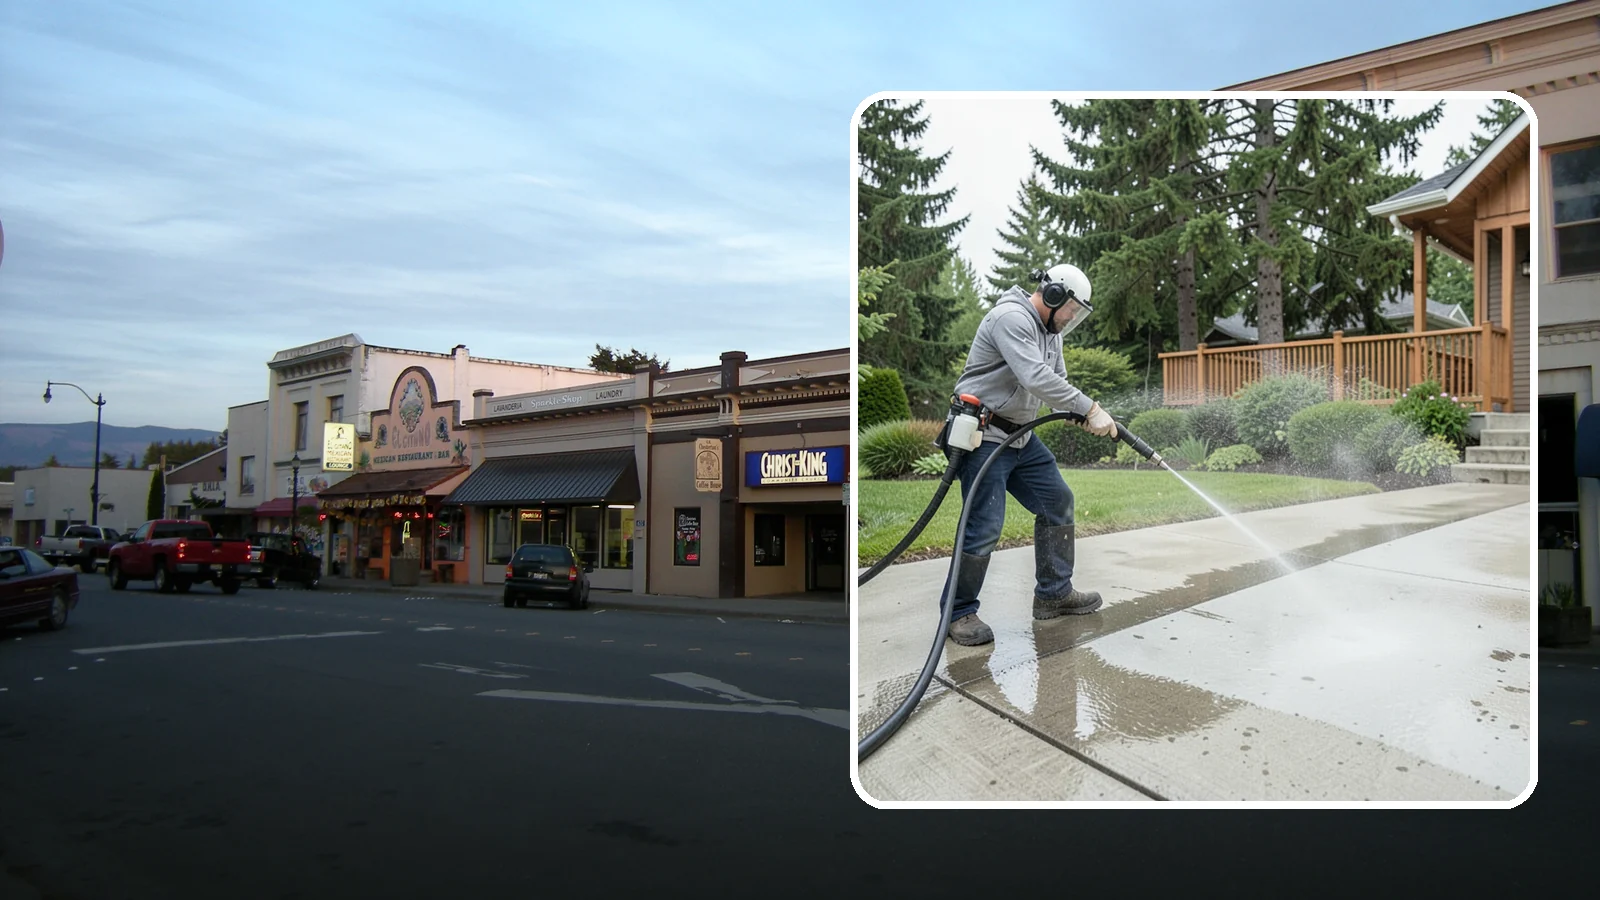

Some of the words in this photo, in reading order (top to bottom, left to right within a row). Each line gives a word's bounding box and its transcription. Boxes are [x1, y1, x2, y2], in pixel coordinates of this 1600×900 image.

[595, 389, 623, 400] LAUNDRY
[493, 402, 523, 412] LAVANDERIA
[531, 396, 562, 409] Sparkle
[562, 394, 582, 404] Shop
[374, 455, 396, 464] MEXICAN
[398, 451, 433, 462] RESTAURANT
[438, 450, 450, 459] BAR
[761, 452, 797, 478] CHRIST
[799, 450, 827, 476] KING
[697, 480, 709, 488] Coffee
[710, 480, 721, 489] House
